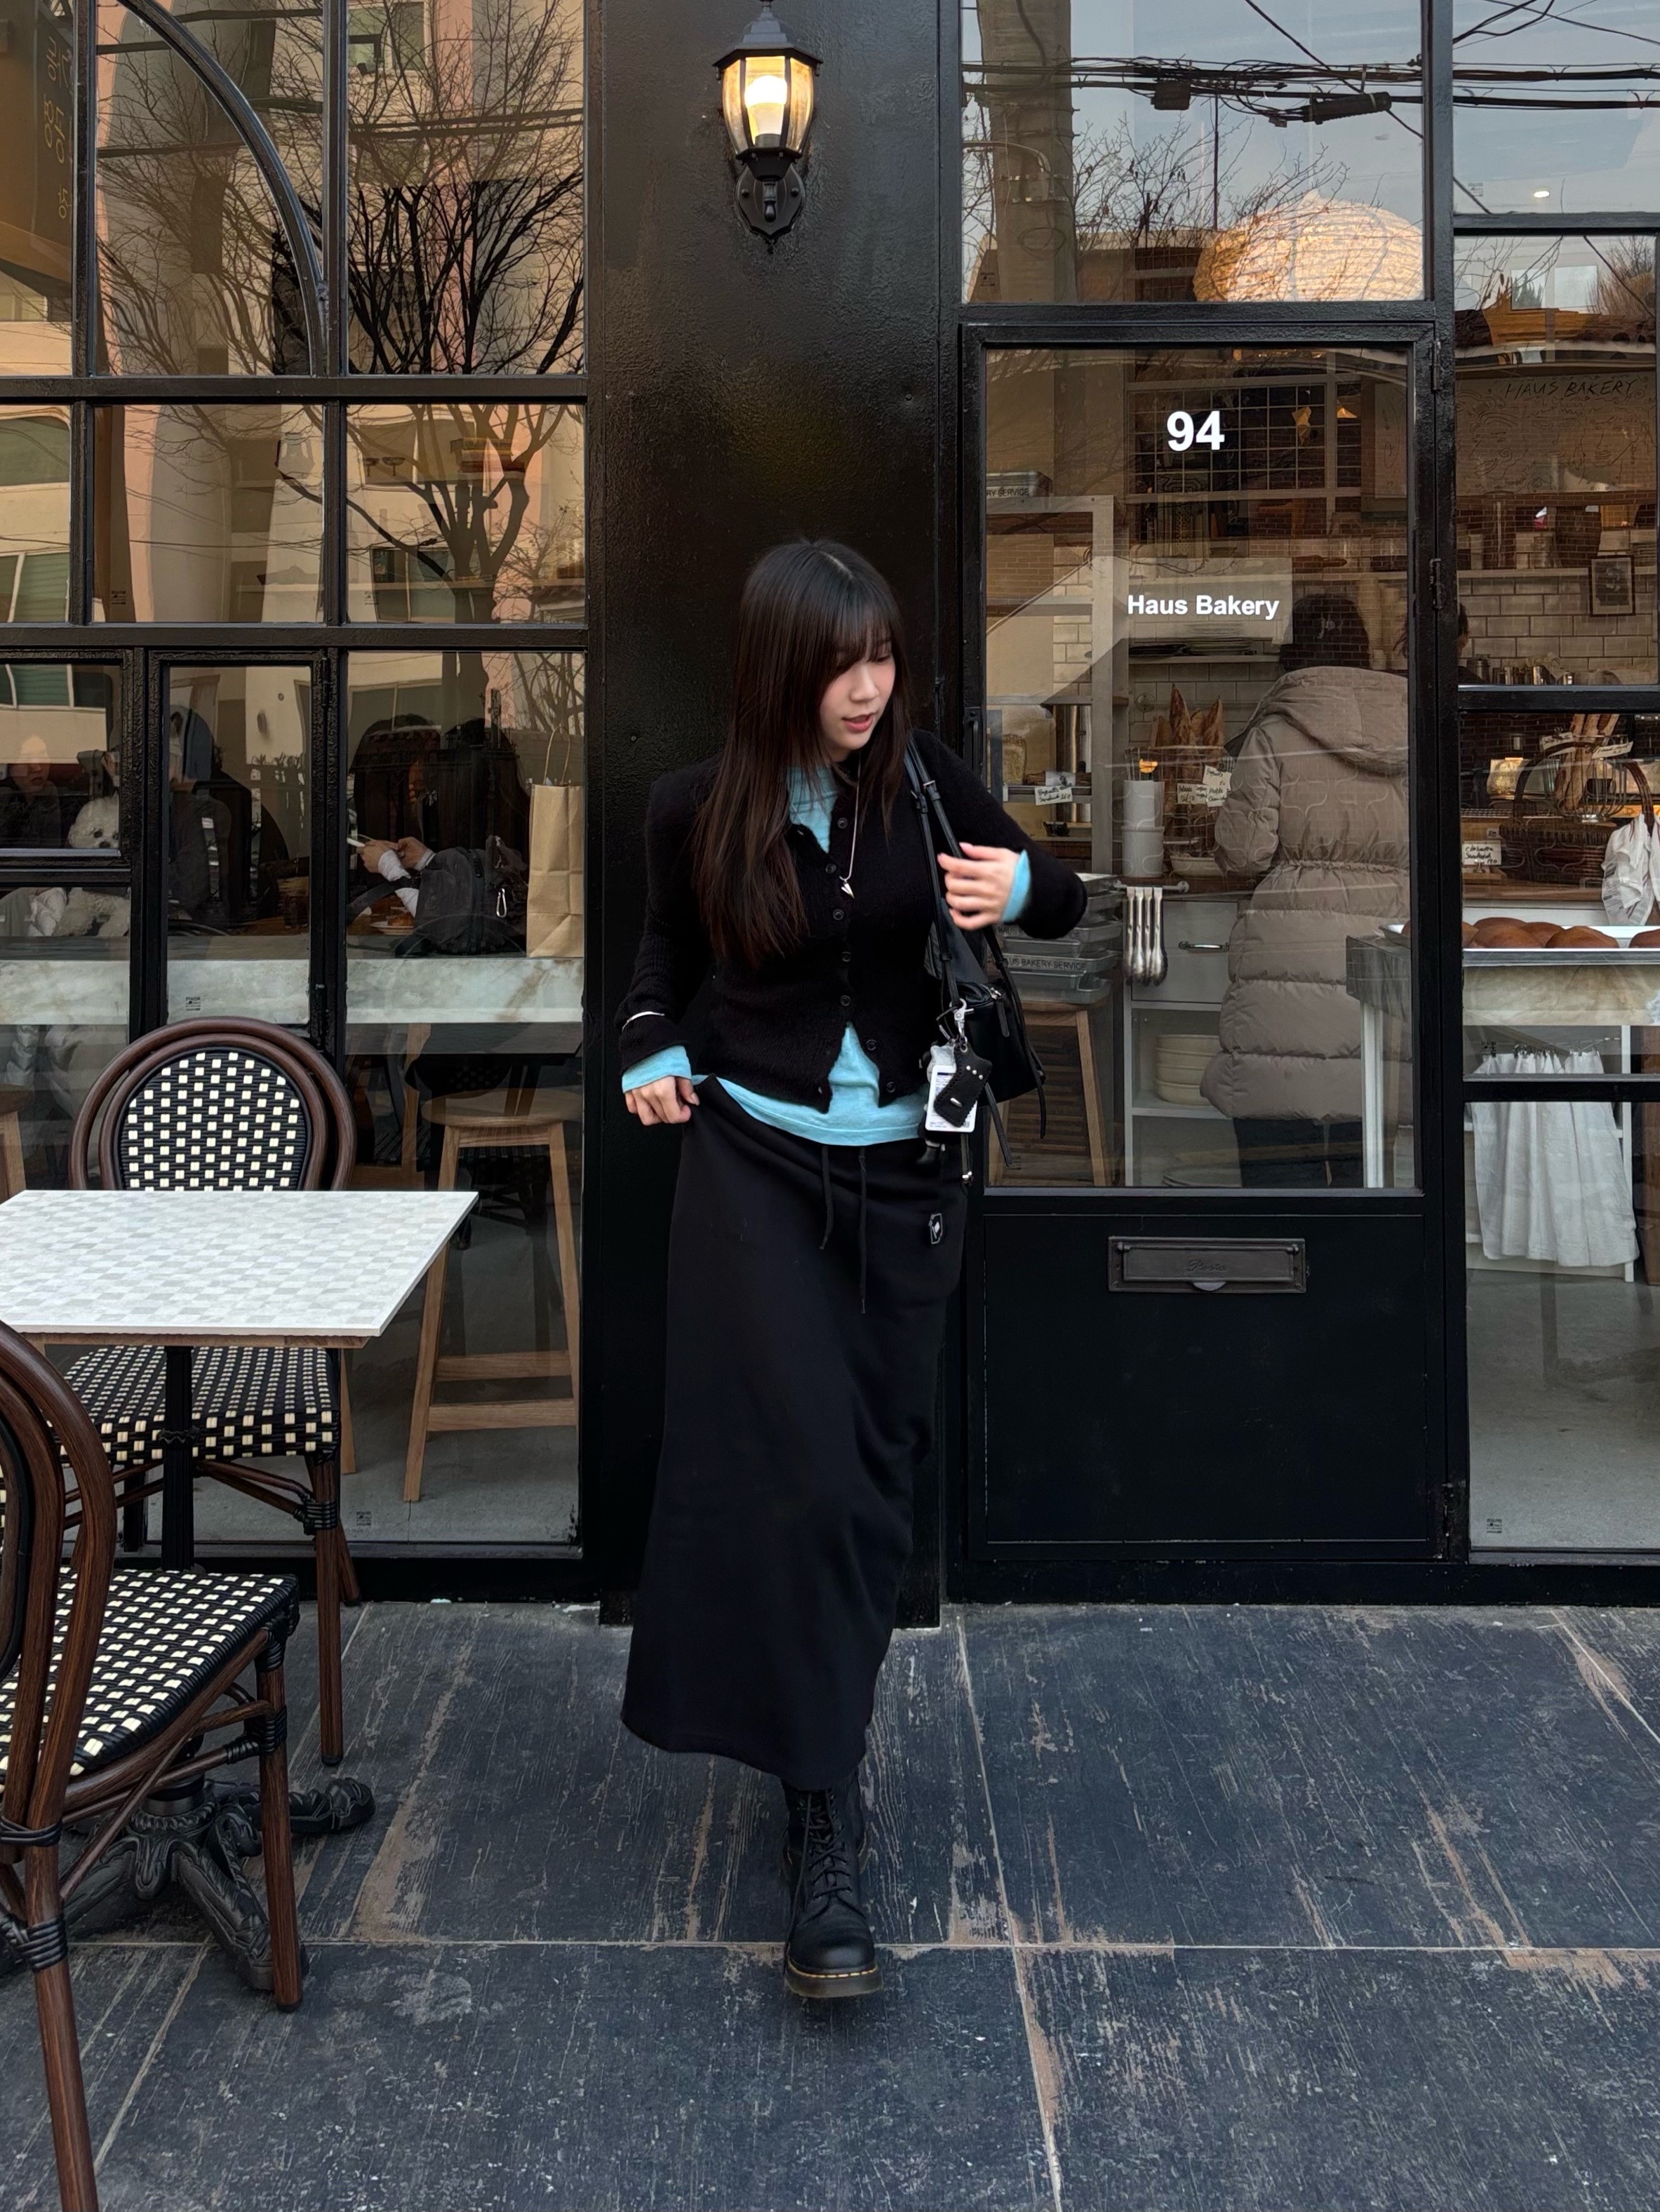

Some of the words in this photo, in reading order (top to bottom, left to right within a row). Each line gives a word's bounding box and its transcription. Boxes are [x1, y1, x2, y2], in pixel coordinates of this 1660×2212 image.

[1505, 381, 1559, 400] HAUS
[1564, 380, 1638, 398] BAKERY
[1166, 410, 1225, 451] 94
[998, 488, 1029, 497] SERVICE
[1127, 595, 1188, 615] Haus
[1196, 595, 1280, 620] Bakery
[1022, 959, 1052, 968] BAKERY
[1054, 960, 1087, 970] SERVICE
